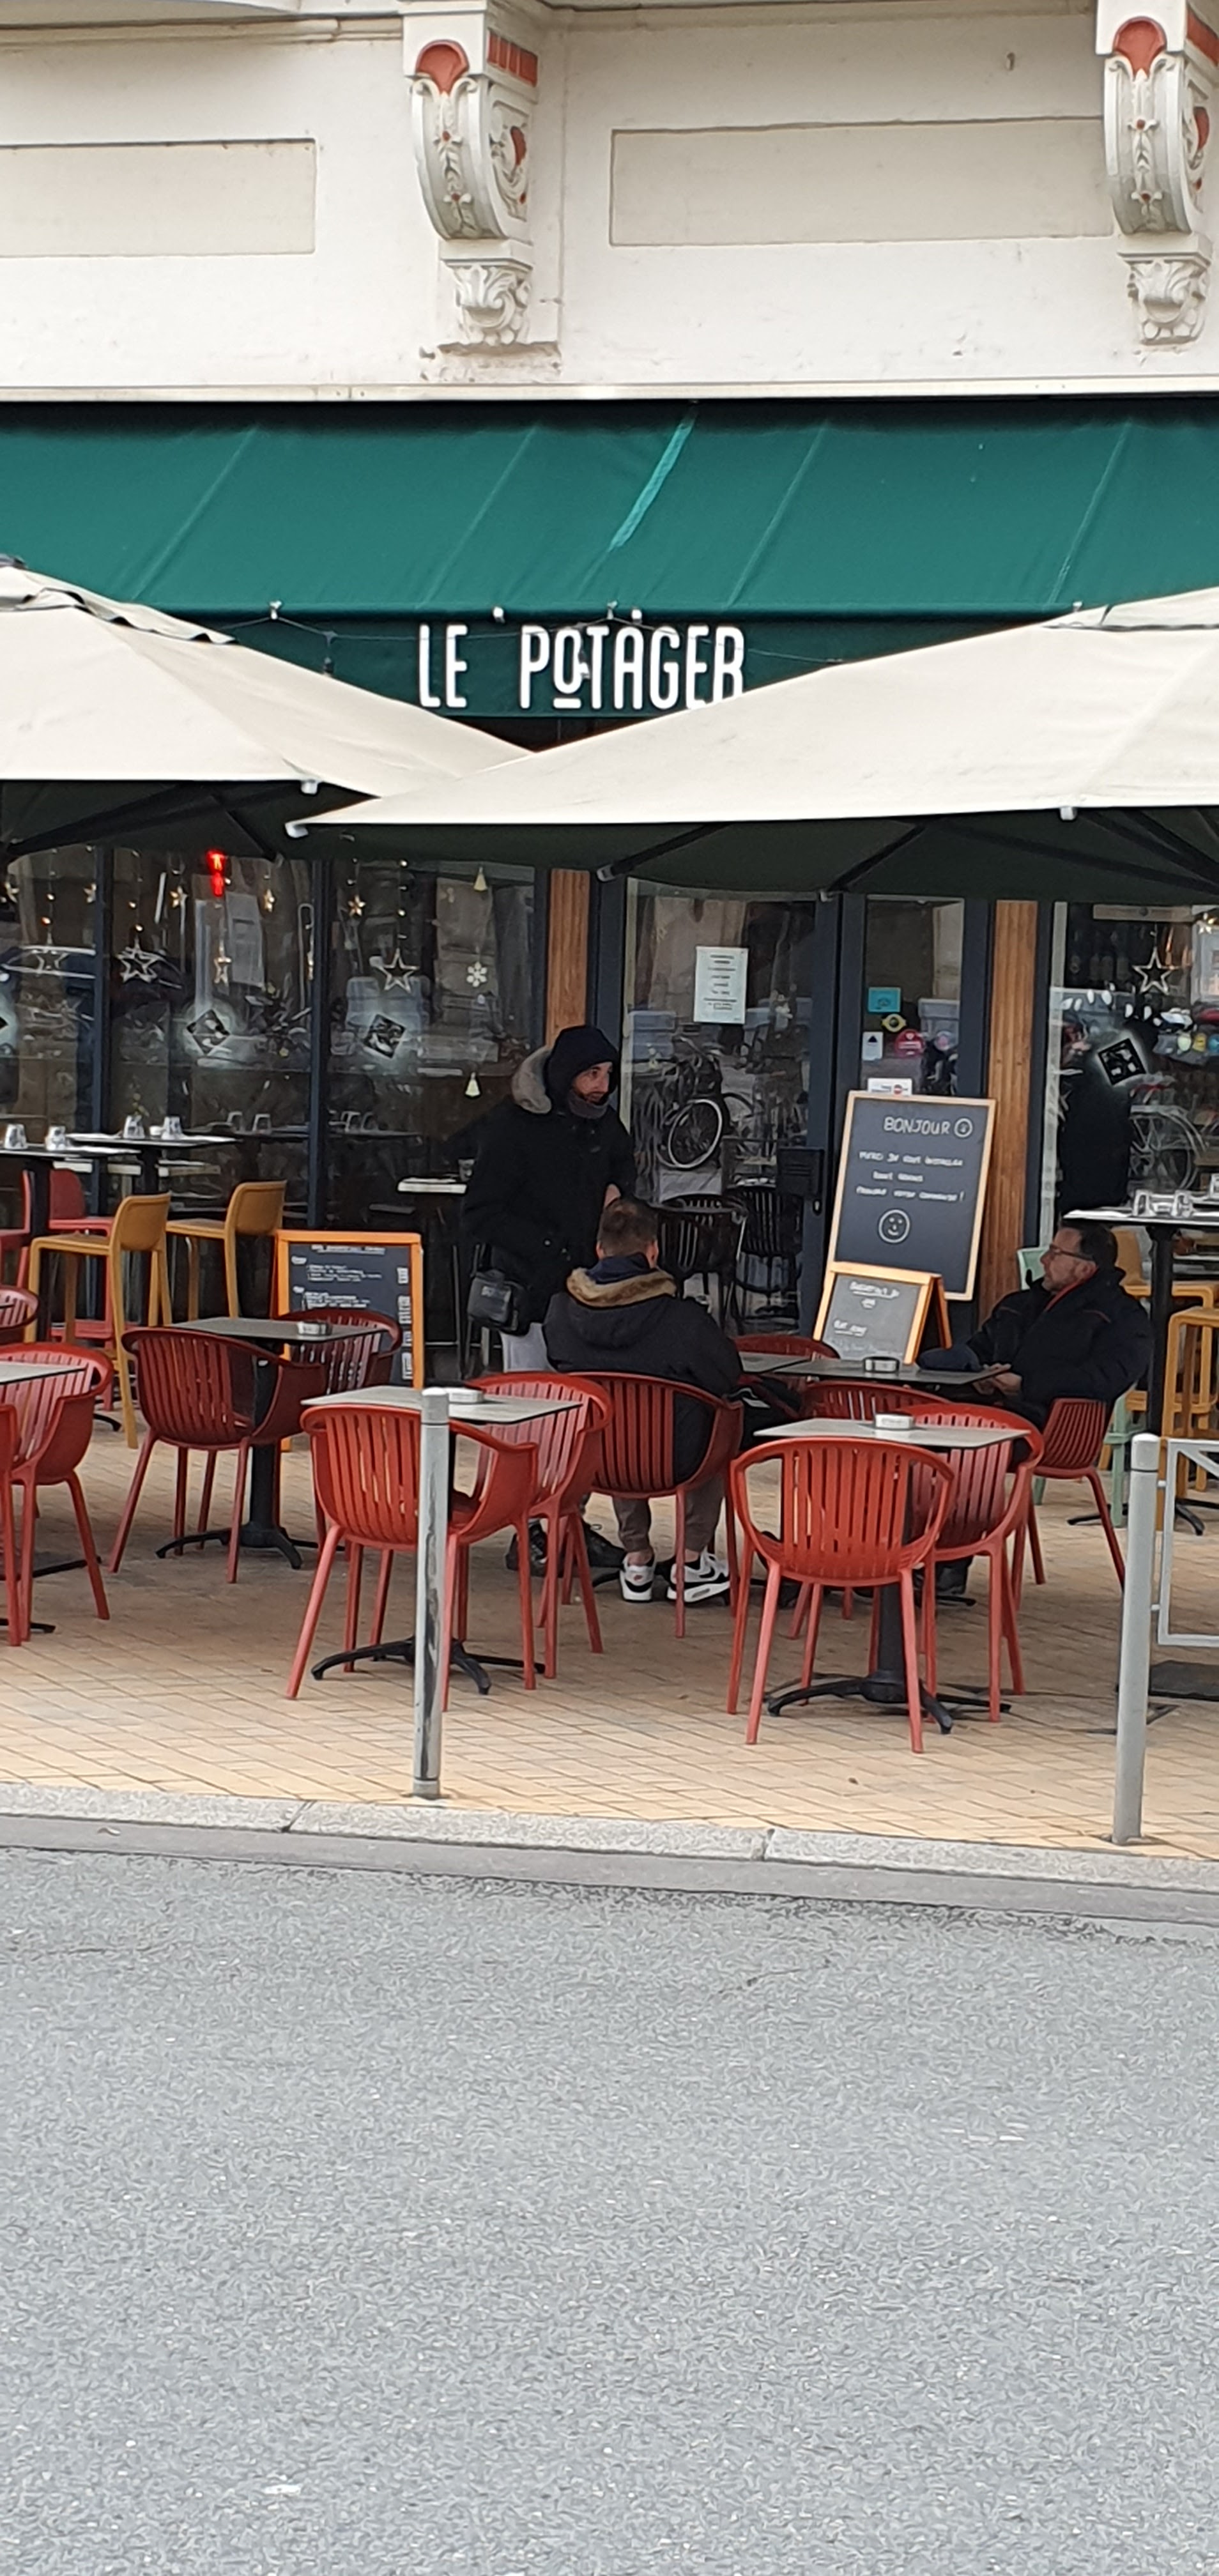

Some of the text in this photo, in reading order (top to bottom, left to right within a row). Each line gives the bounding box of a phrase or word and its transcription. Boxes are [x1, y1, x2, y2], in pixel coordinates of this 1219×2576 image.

[419, 624, 744, 709] LE POTAGER
[884, 1116, 951, 1135] BONJOUR
